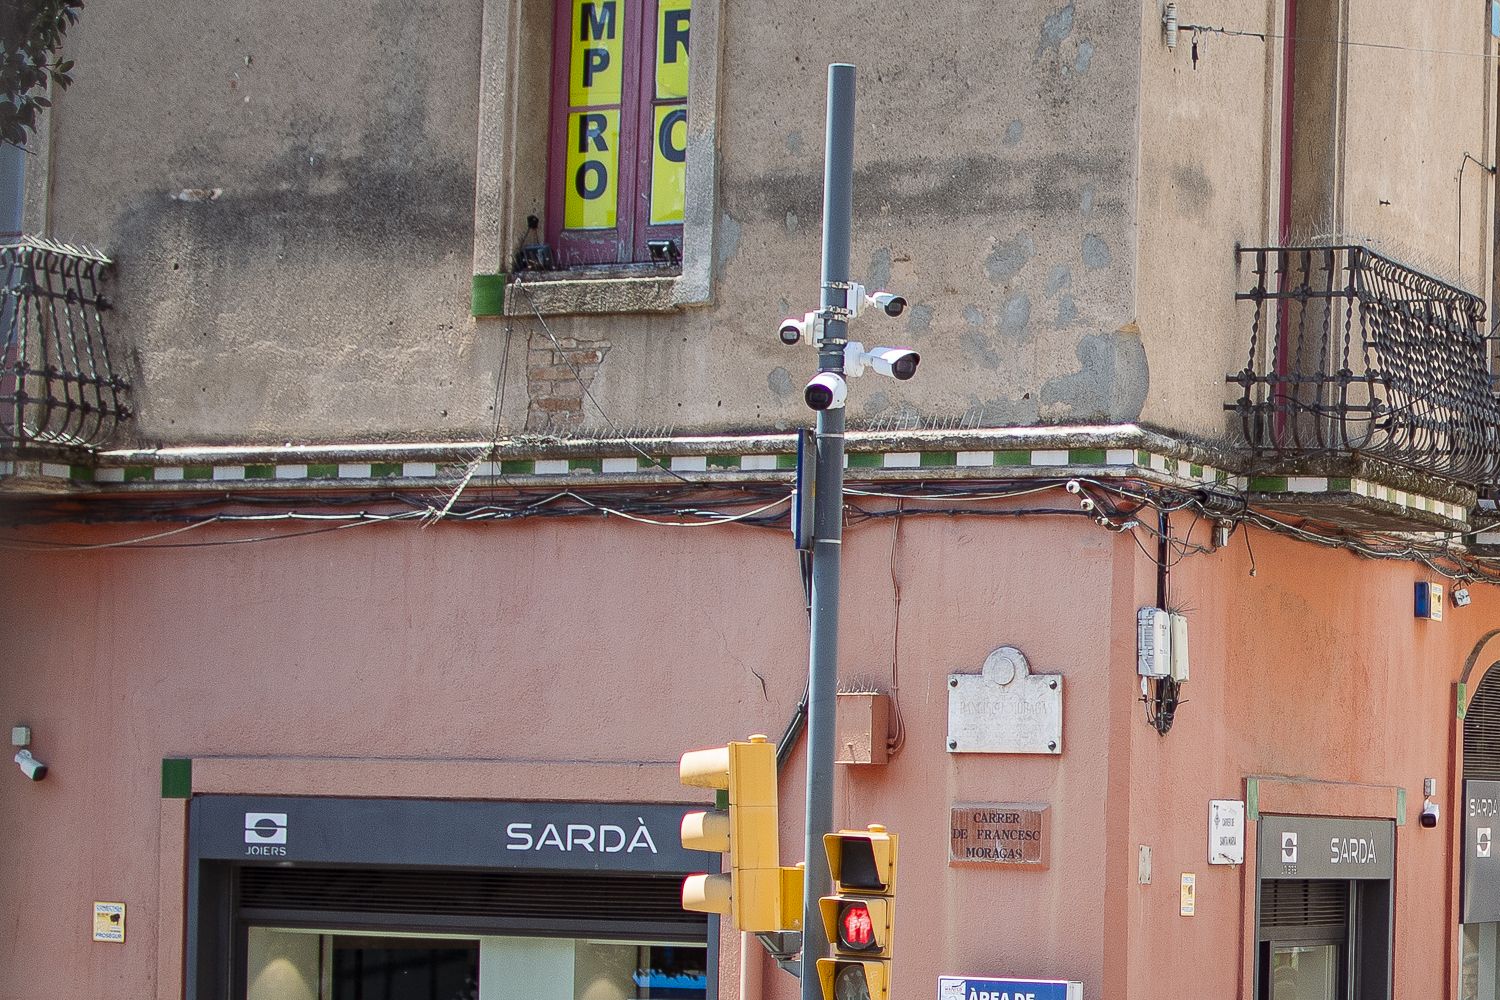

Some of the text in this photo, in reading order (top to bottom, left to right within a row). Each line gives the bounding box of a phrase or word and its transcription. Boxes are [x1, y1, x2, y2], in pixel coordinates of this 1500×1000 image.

[973, 812, 1020, 824] CARRER
[506, 816, 658, 854] SARDÀ
[952, 828, 1041, 841] DE FRANCESC
[244, 846, 287, 857] JOIERS
[965, 846, 1023, 860] MORAGAS
[1329, 830, 1377, 865] SARDÀ
